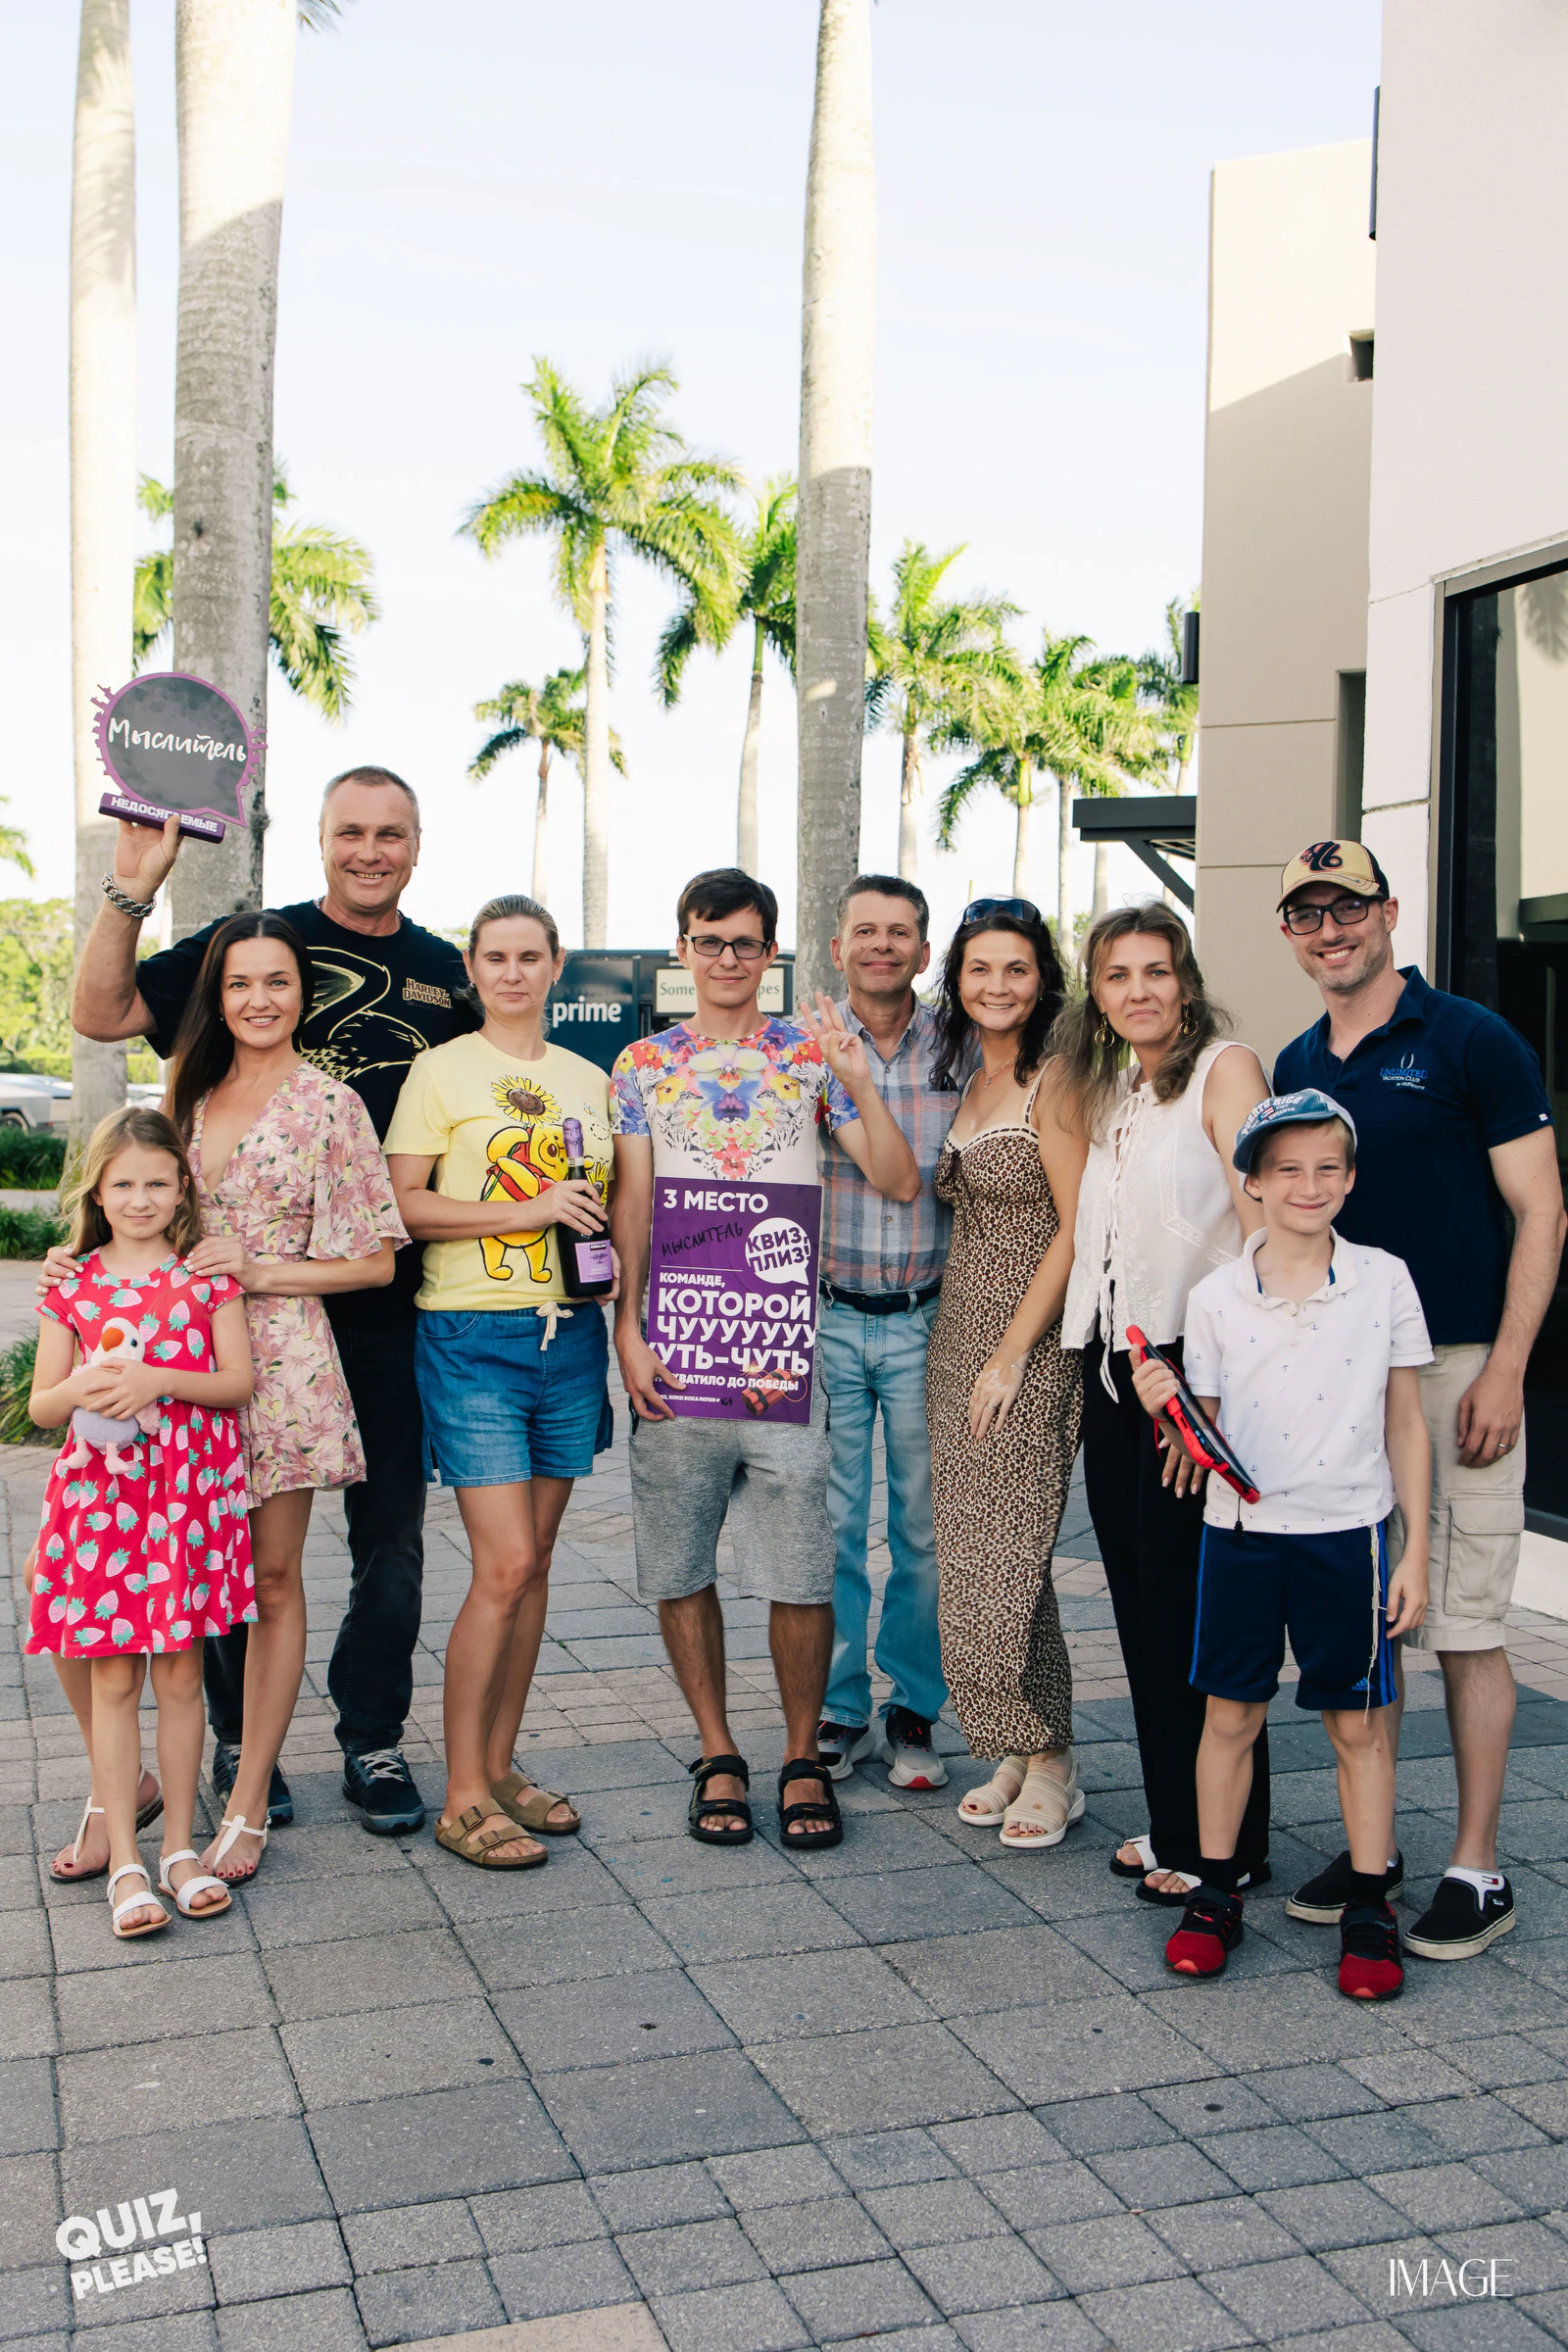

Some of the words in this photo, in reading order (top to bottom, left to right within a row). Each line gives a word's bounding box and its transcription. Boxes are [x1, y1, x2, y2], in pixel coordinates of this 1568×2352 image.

[108, 717, 247, 761] Мыслитель
[111, 796, 218, 833] НЕДОСЯГЕМЫЕ
[403, 988, 452, 1008] DAVIDSON
[406, 978, 450, 998] HARLEY-
[552, 996, 622, 1028] prime
[1380, 1068, 1428, 1079] UNLIMITED
[1242, 1098, 1271, 1135] PUERTO
[1273, 1096, 1303, 1106] RICO
[662, 1189, 678, 1208] 3
[684, 1190, 769, 1213] МЕСТО
[747, 1226, 809, 1254] КВИЗ,
[748, 1245, 811, 1273] ПЛИЗ!
[659, 1272, 726, 1288] КОМАНДЕ,
[658, 1288, 811, 1321] КОТОРОЙ
[726, 1376, 747, 1389] ДО
[748, 1379, 799, 1391] ПОБЕДЫ
